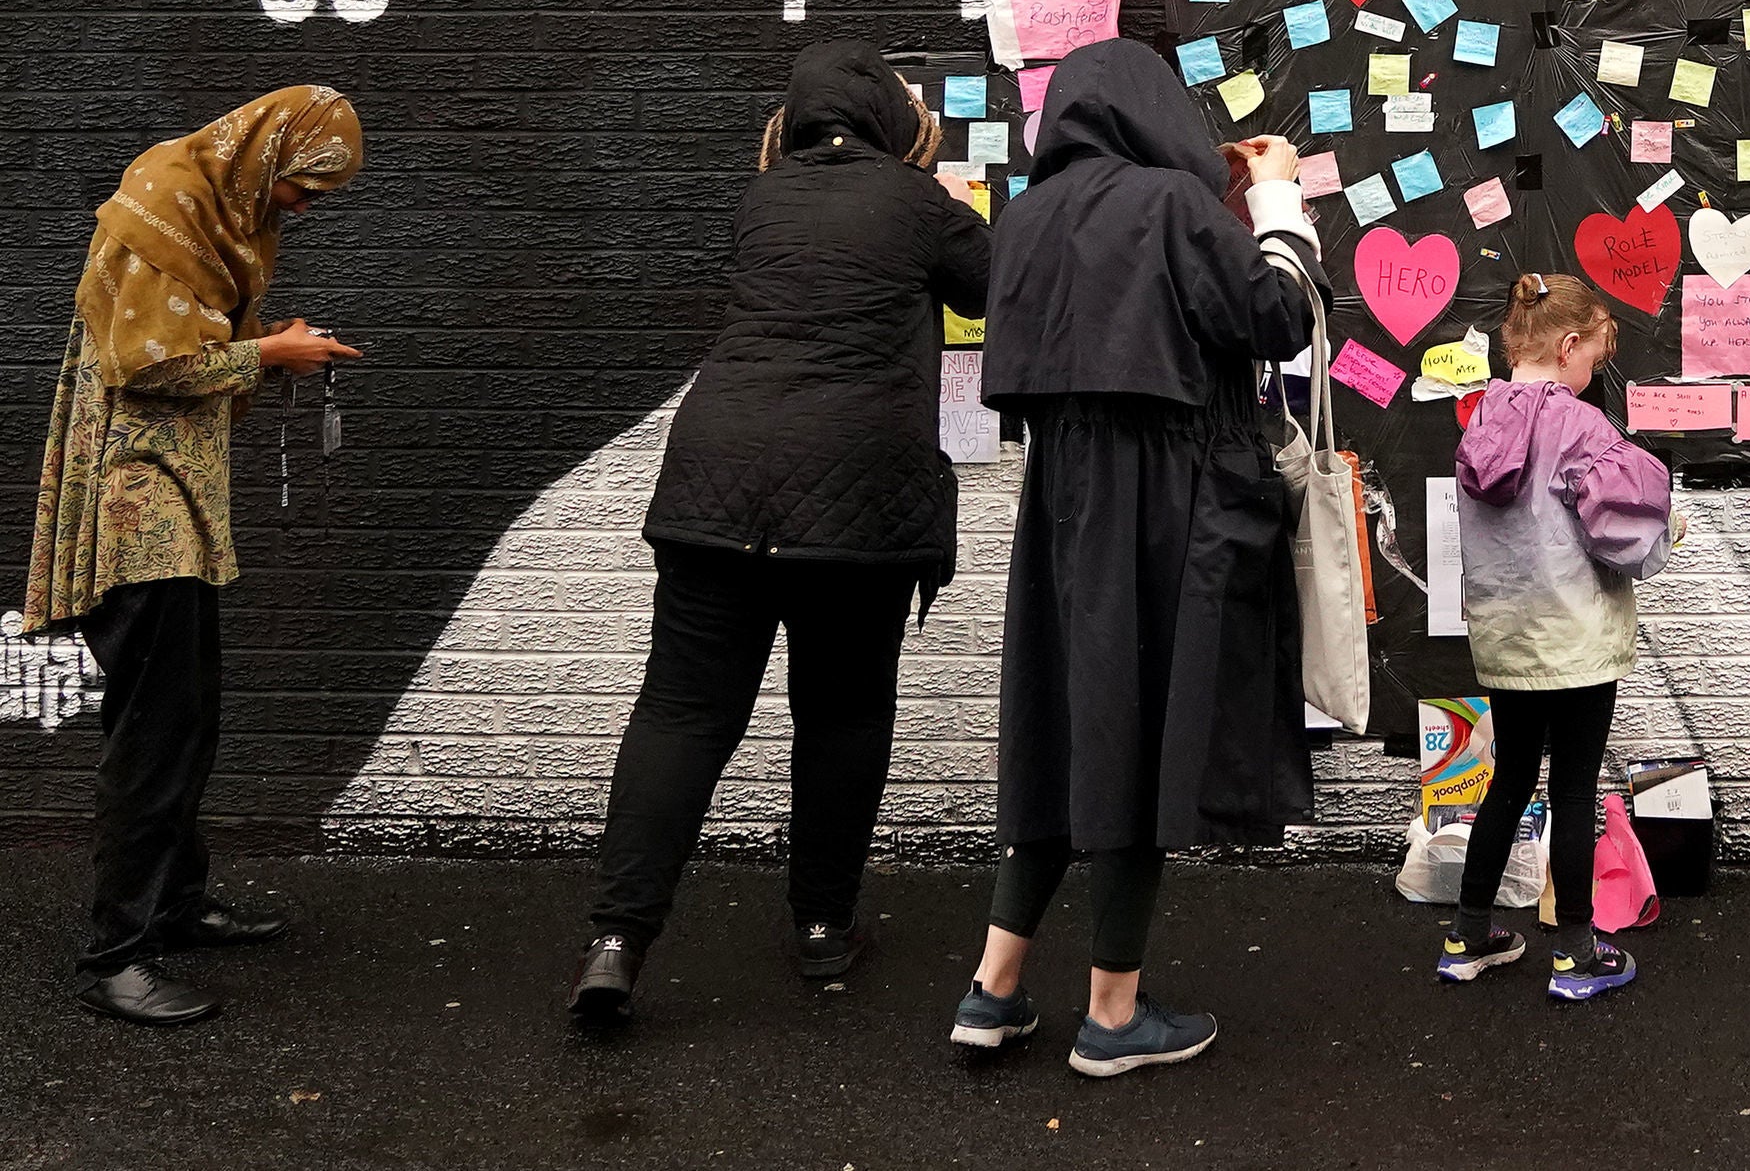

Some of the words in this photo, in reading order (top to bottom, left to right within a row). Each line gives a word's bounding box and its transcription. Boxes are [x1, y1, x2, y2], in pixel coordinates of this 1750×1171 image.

[1604, 227, 1657, 263] ROLE
[1376, 259, 1446, 299] HERO
[1612, 256, 1669, 290] MODEL
[1629, 389, 1646, 398] You
[1653, 391, 1667, 399] are
[1425, 732, 1451, 751] 28
[1432, 768, 1490, 802] scrapbook
